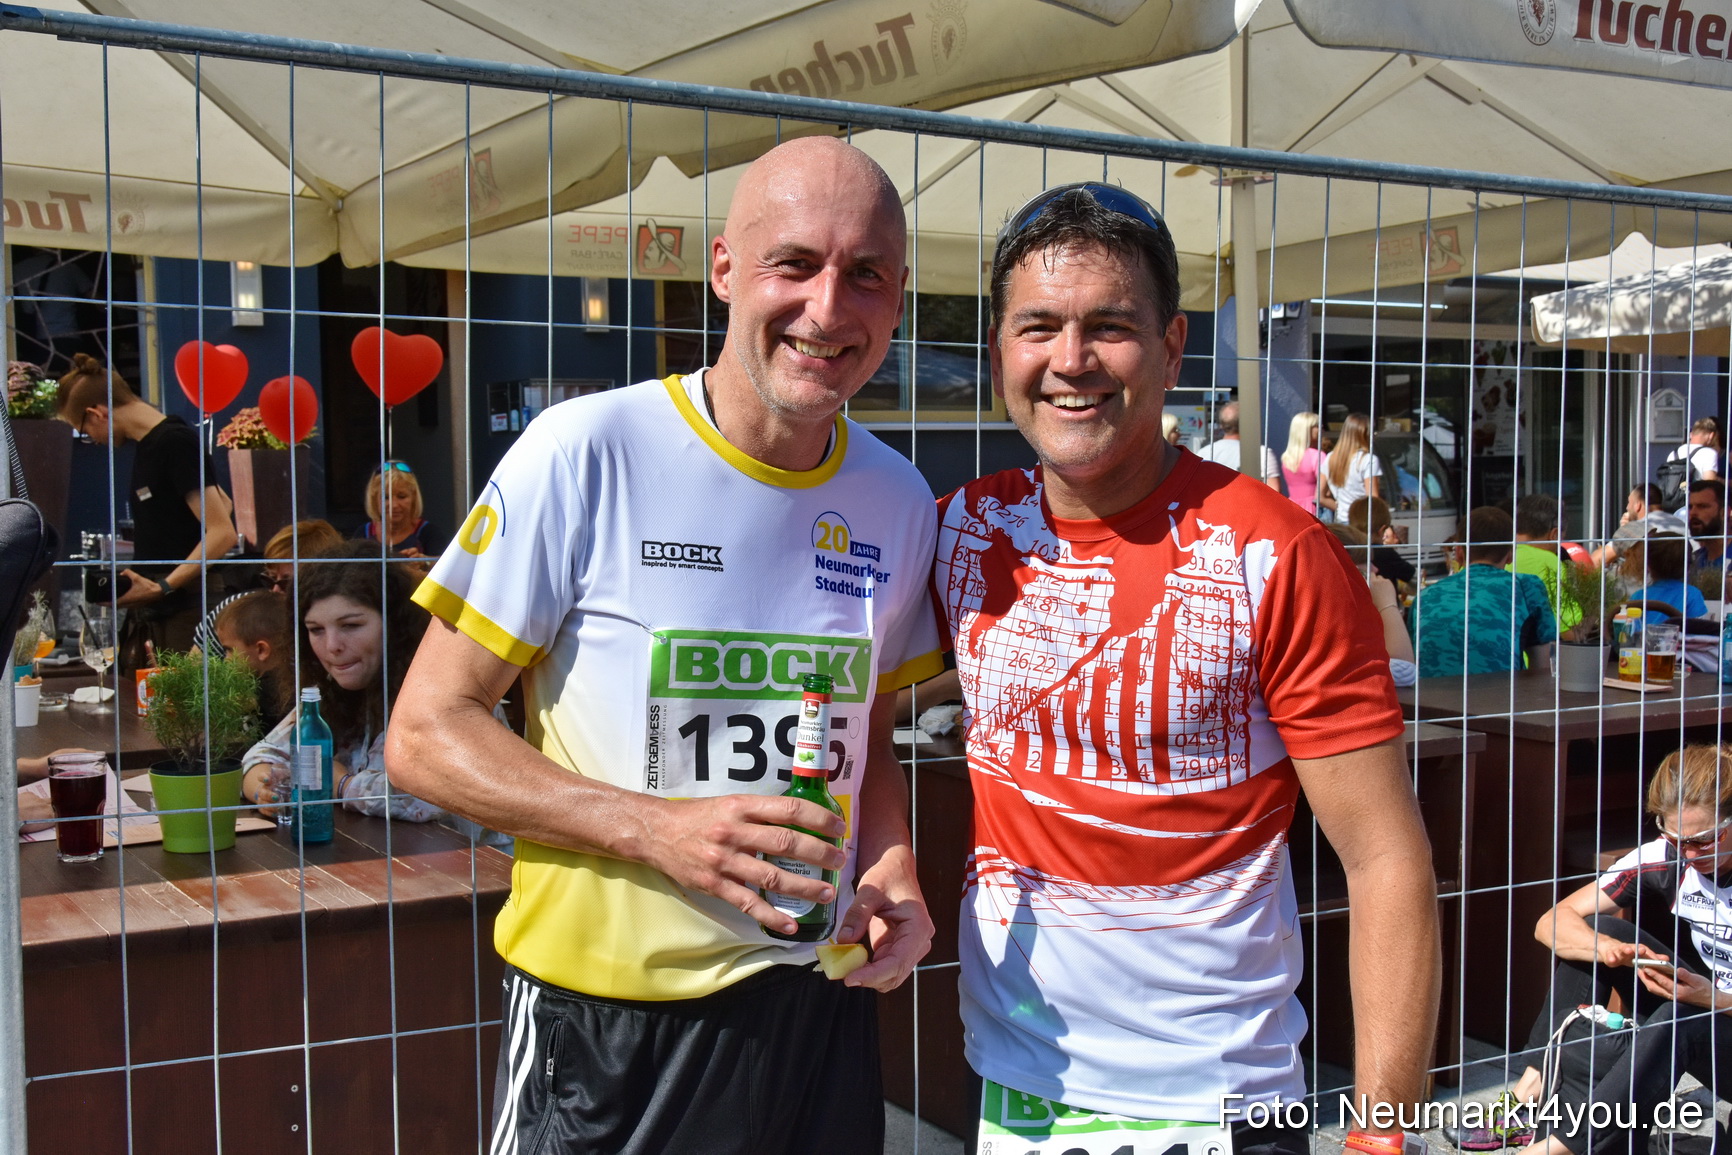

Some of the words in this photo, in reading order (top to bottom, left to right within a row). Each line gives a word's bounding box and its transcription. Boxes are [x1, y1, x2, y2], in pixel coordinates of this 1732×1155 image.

[1573, 0, 1732, 62] Tuche
[816, 521, 848, 553] 20
[852, 543, 879, 558] JAHRE
[641, 560, 667, 568] inspired
[642, 541, 723, 566] BOCK
[815, 554, 890, 583] Neumarker
[815, 575, 876, 599] Stadtlau
[668, 637, 860, 695] BOCK
[1008, 650, 1056, 674] 26.22
